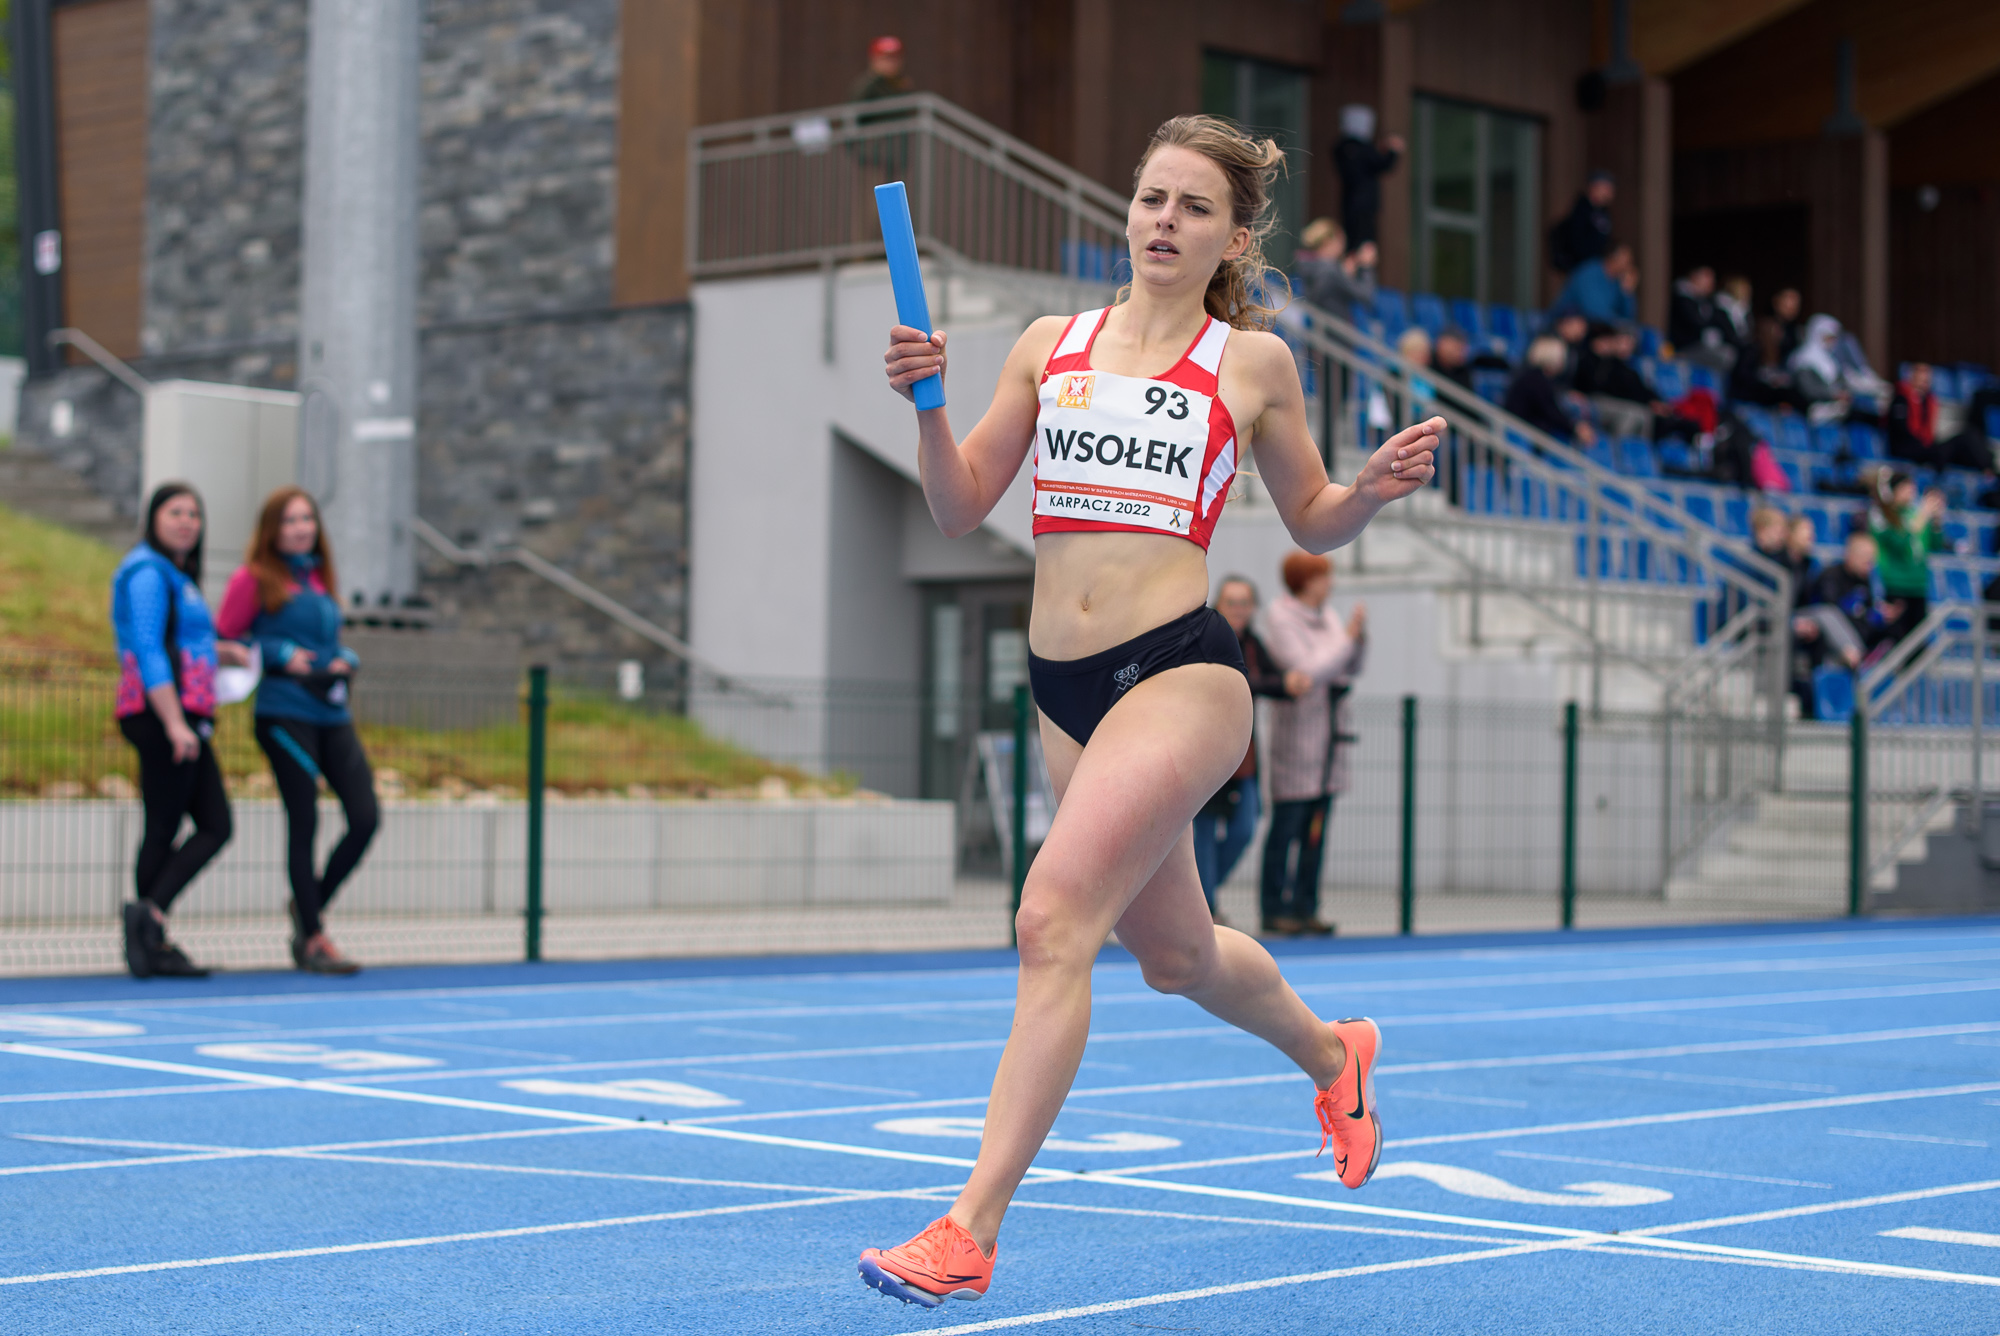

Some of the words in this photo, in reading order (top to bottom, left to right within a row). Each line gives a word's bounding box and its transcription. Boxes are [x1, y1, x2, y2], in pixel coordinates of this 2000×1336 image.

[1058, 396, 1088, 408] PZLA
[1144, 386, 1190, 420] 93
[1045, 428, 1194, 479] WSOŁEK
[1049, 495, 1112, 512] KARPACZ
[1115, 502, 1151, 516] 2022
[196, 1042, 447, 1070] 5
[872, 1117, 1182, 1152] 3
[1293, 1161, 1674, 1207] 2
